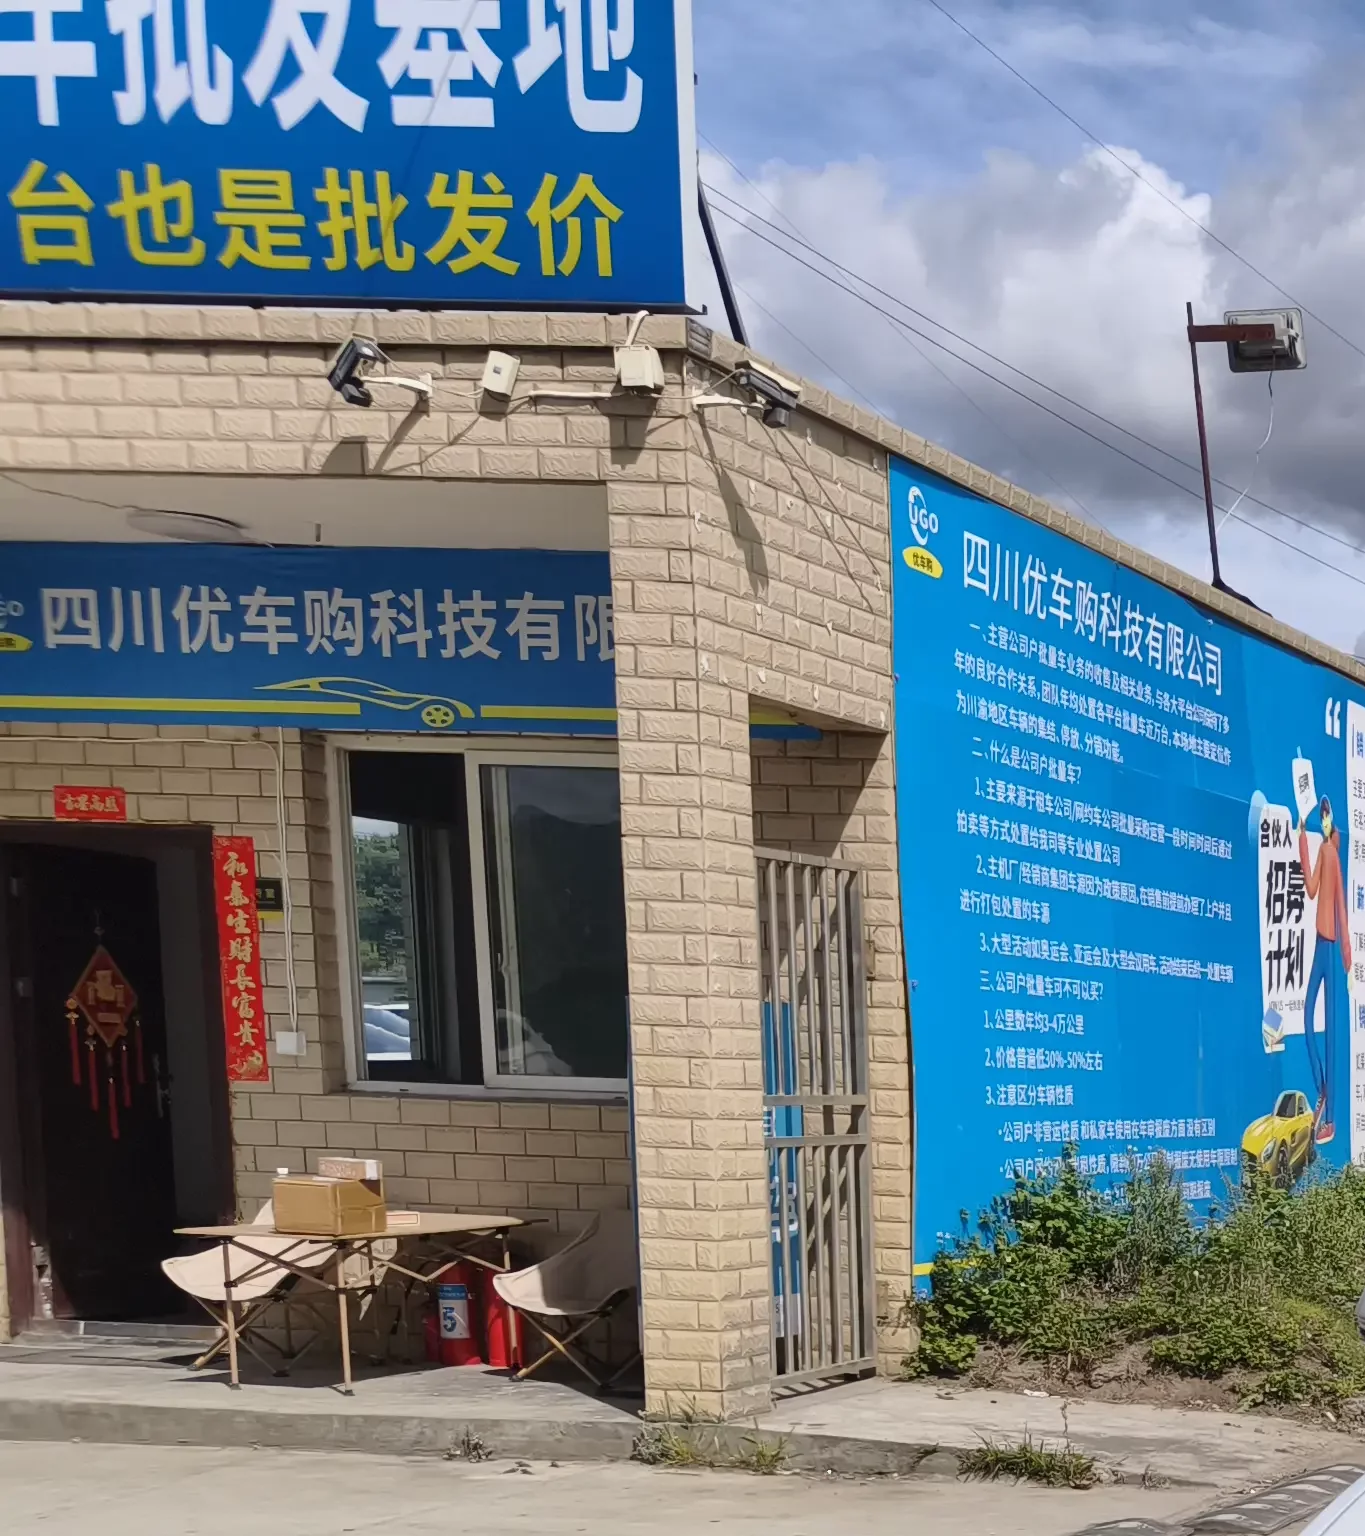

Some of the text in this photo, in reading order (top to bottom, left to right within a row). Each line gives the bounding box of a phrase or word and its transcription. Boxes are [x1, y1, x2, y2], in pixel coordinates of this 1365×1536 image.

[8, 158, 623, 277] 台也是批发价
[908, 502, 939, 534] UGO
[41, 586, 614, 662] 四川优车购科技有限
[963, 530, 1222, 696] 四川优车购科技有限公司
[1260, 819, 1293, 850] 合伙人
[1265, 859, 1305, 925] 招募
[1265, 928, 1305, 996] 计划
